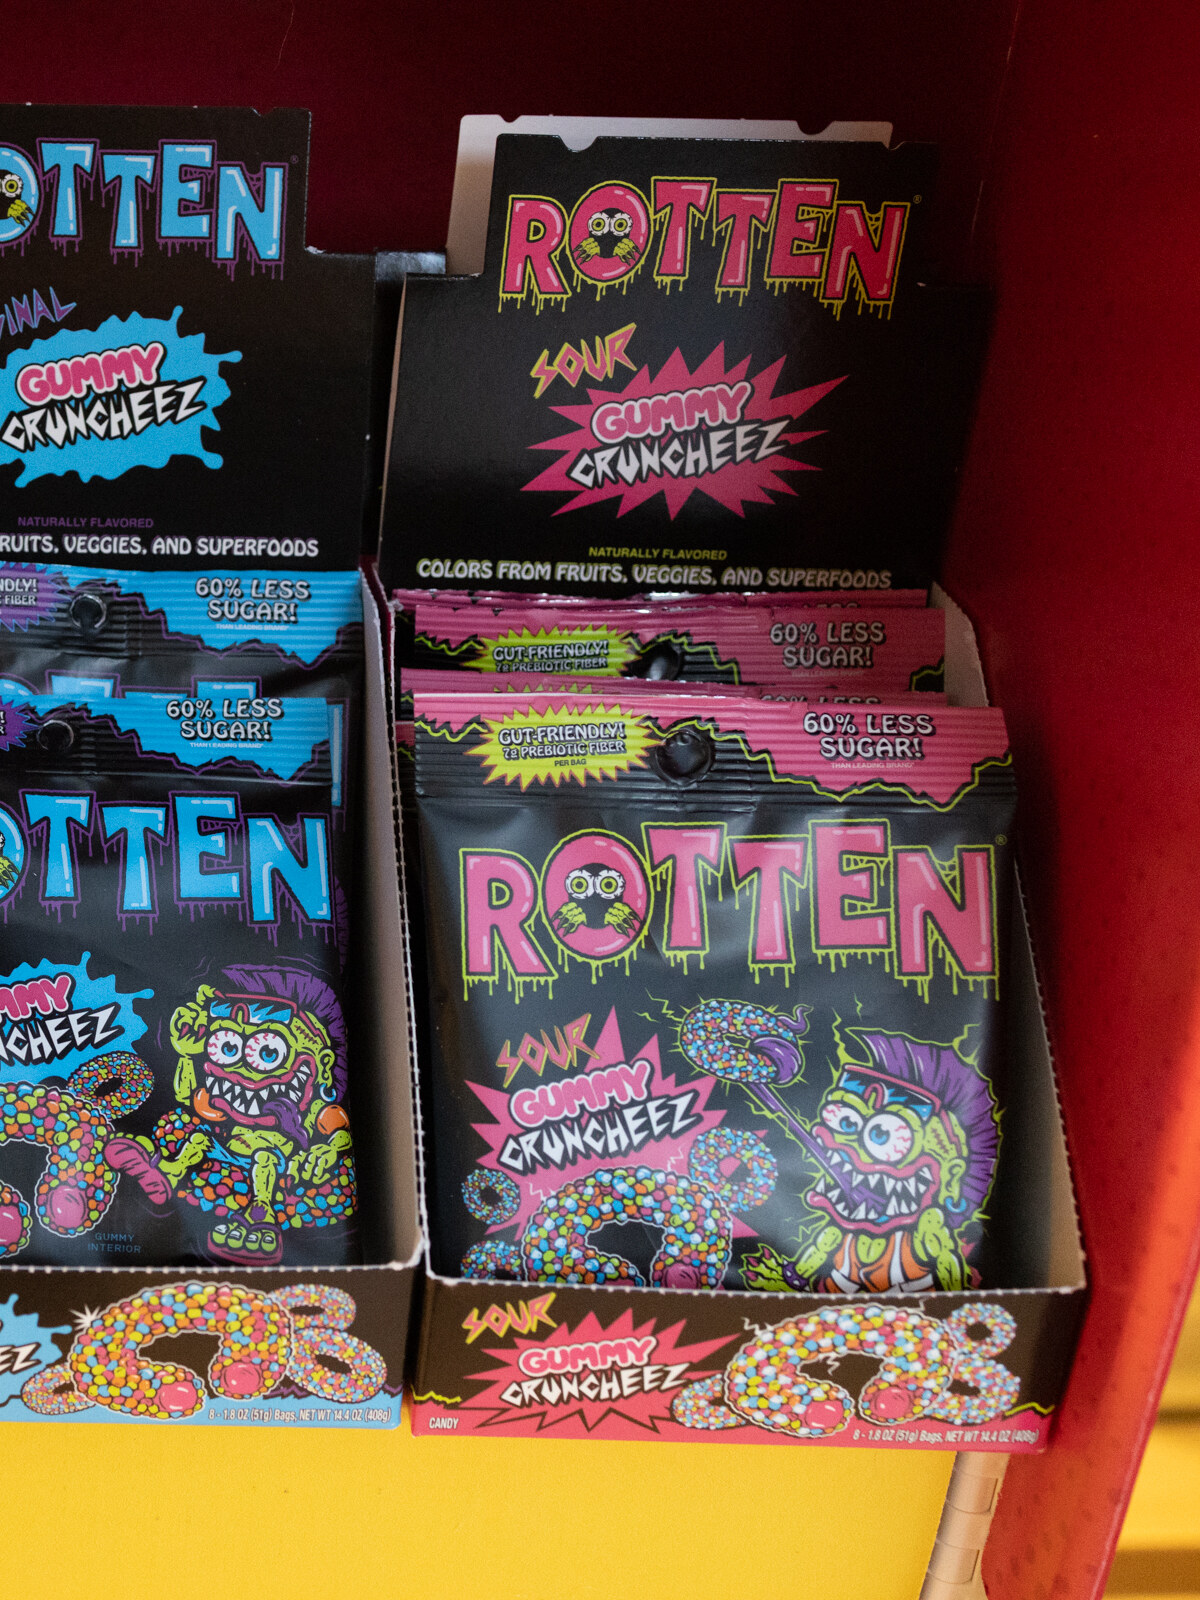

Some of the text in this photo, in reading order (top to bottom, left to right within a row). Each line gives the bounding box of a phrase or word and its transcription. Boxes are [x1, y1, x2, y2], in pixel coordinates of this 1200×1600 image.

[497, 176, 911, 320] ROTTEN
[530, 322, 638, 399] SOUR
[16, 341, 164, 407] GUMMY
[0, 378, 205, 453] CRUNCHEEZ
[591, 380, 752, 443] GUMMY
[567, 419, 790, 488] CRUNCHEEZ
[18, 517, 154, 528] NATURALLY FLAVORED
[152, 535, 192, 555] AND
[196, 535, 319, 558] SUPERFOODS
[588, 546, 728, 560] NATURALLY FLAVORED
[416, 558, 493, 579] COLORS
[496, 560, 551, 581] FROM
[721, 566, 763, 586] AND
[766, 567, 892, 588] SUPERFOODS
[5, 595, 36, 605] FIBER
[196, 578, 312, 600] 60% LESS
[208, 599, 298, 623] SUGAR!
[770, 622, 886, 644] 60% LESS
[493, 640, 609, 661] GUT-FRIENDLY!
[783, 646, 874, 668] SUGAR!
[512, 659, 573, 672] PREBIOTIC
[574, 657, 607, 669] FIBER
[166, 699, 284, 720] 60% LESS
[180, 720, 272, 741] SUGAR!
[499, 722, 626, 746] GUT-FRIENDLY!
[803, 712, 937, 736] 60% LESS
[521, 743, 587, 758] PREBIOTIC
[589, 740, 625, 754] FIBER
[820, 737, 925, 760] SUGAR!
[460, 819, 999, 1003] ROTTEN
[496, 1013, 600, 1088] SOUR
[510, 1060, 650, 1127] GUMMY
[499, 1092, 698, 1171] CRUNCHEEZ
[87, 1243, 141, 1253] INTERIOR
[95, 1232, 135, 1242] GUMMY
[462, 1292, 557, 1344] SOUR
[518, 1335, 657, 1378] GUMMY
[500, 1362, 690, 1406] CRUNCHEEZ
[208, 1408, 216, 1420] 8
[223, 1409, 236, 1420] 1.8
[237, 1408, 249, 1420] OZ
[250, 1408, 272, 1422] (51g)
[274, 1409, 298, 1422] Bags,
[299, 1409, 317, 1421] NET
[317, 1409, 332, 1421] WT
[333, 1409, 350, 1421] 14.4
[351, 1409, 363, 1421] OZ
[364, 1409, 391, 1423] (408g)
[429, 1417, 459, 1429] CANDY
[945, 1430, 963, 1442] NET
[964, 1430, 979, 1442] WT
